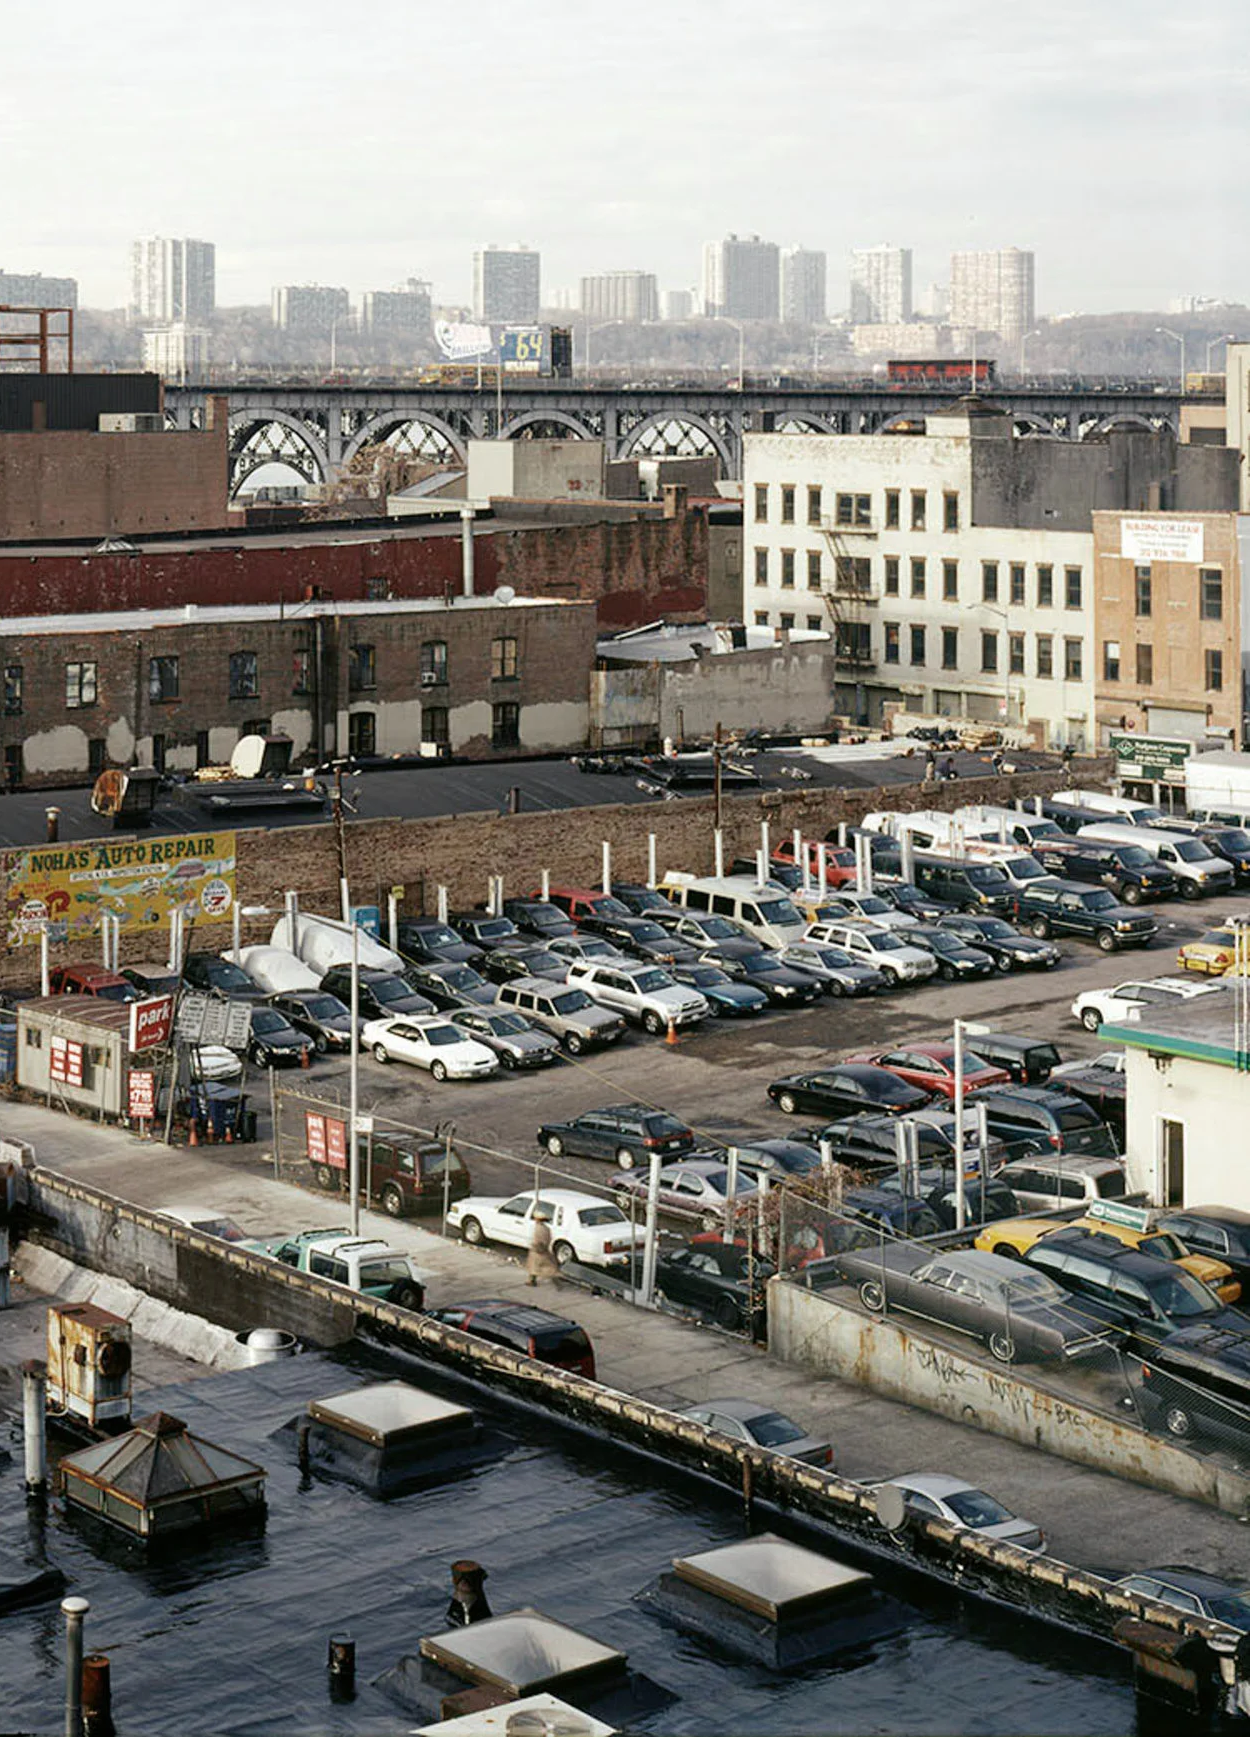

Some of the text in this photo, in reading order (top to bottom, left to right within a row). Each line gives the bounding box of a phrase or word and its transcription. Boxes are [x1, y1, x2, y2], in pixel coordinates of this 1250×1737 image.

[516, 333, 543, 360] 64
[31, 838, 216, 873] NOHA'S AUTO REPAIR
[138, 1002, 170, 1032] park
